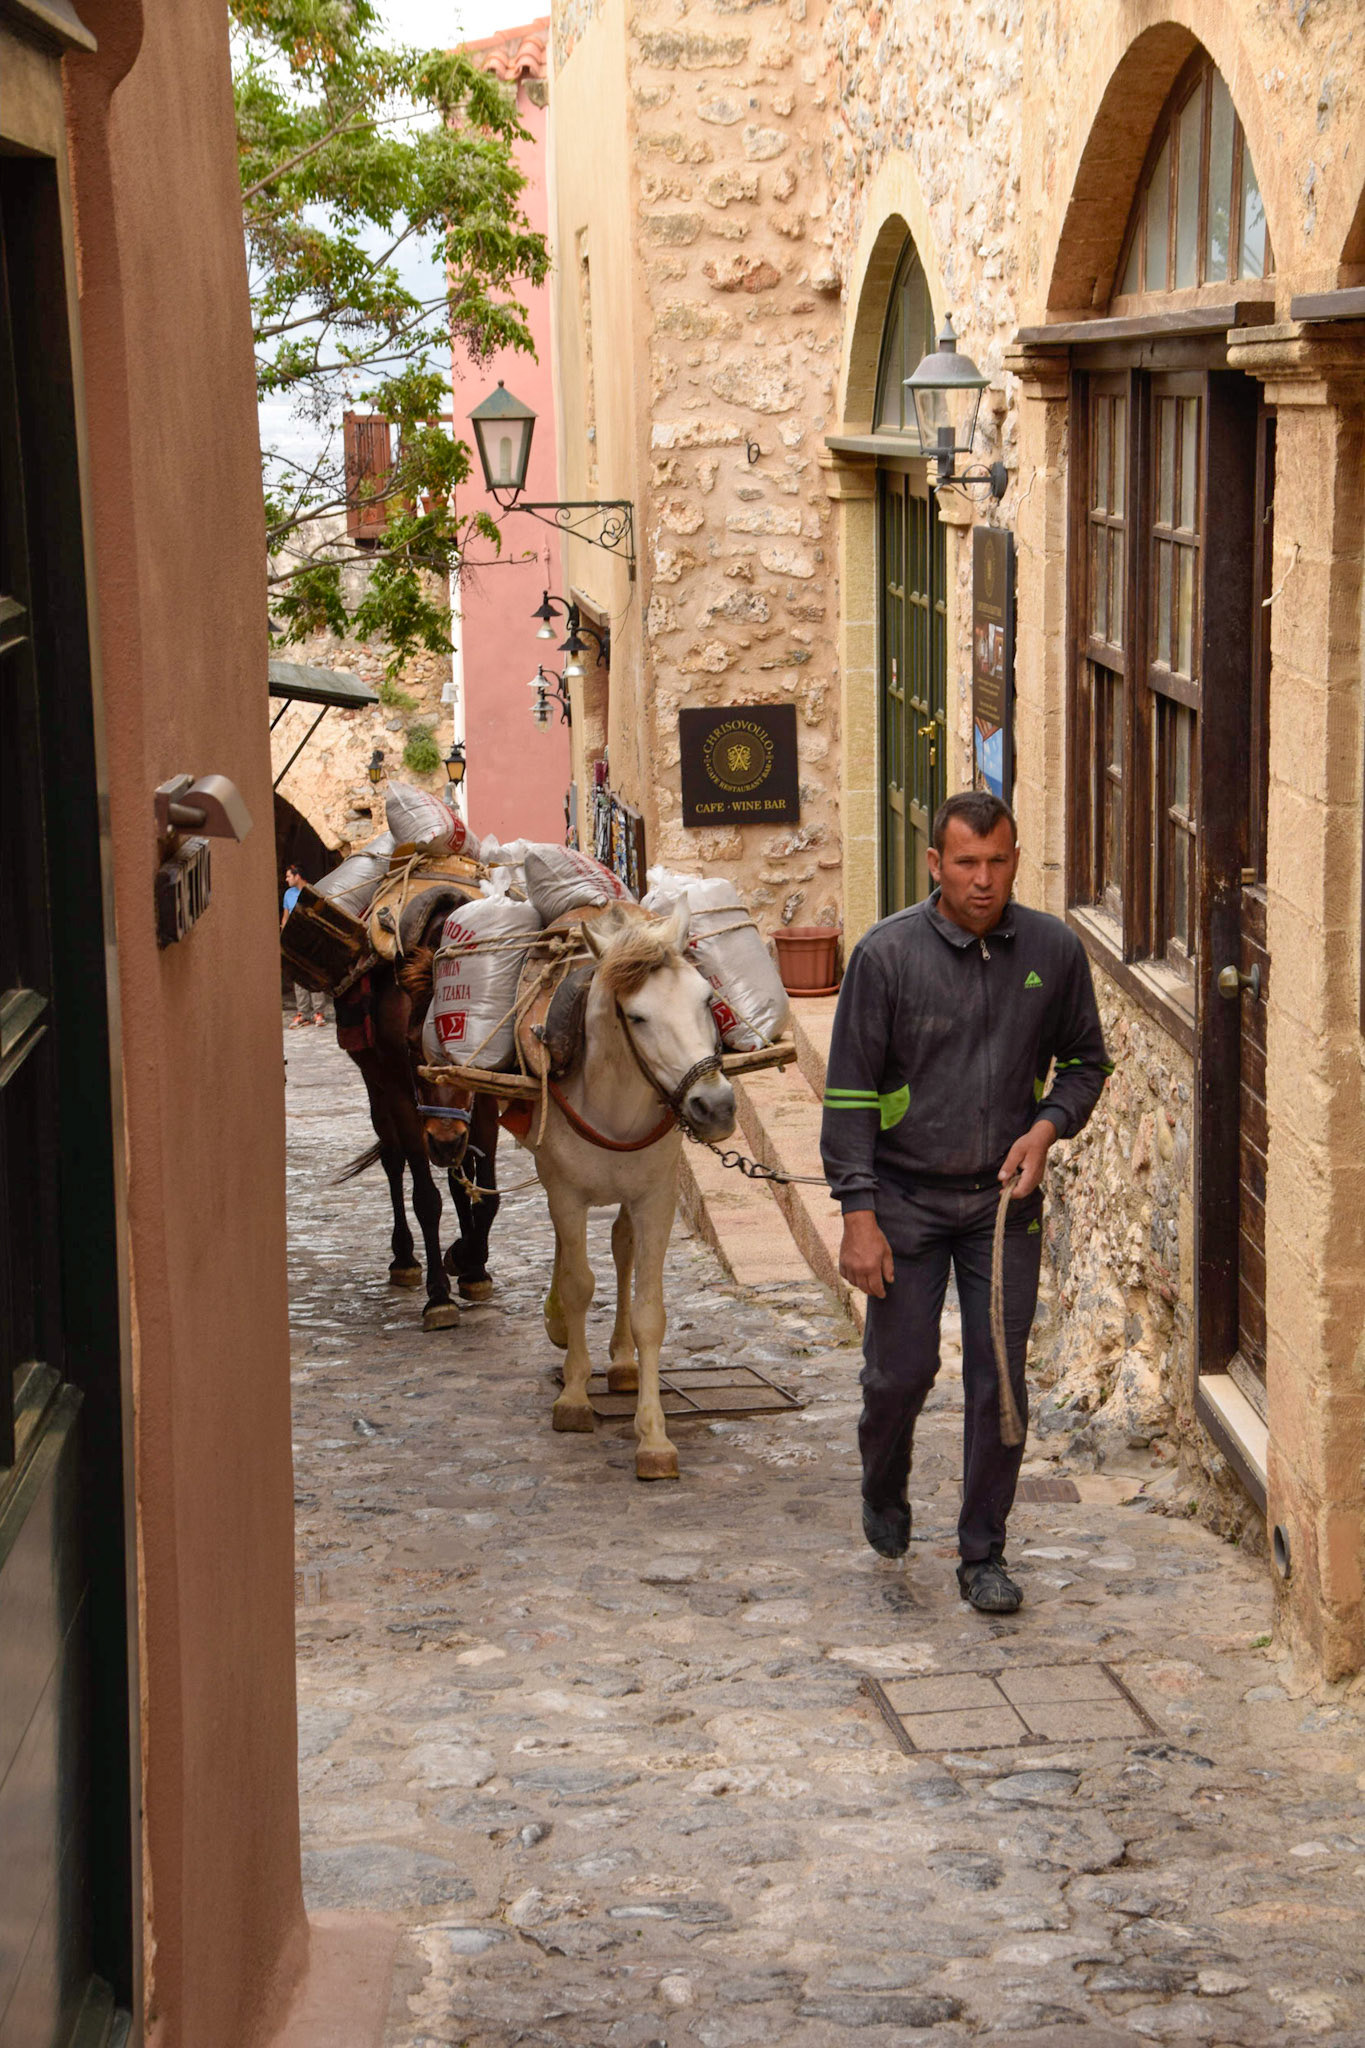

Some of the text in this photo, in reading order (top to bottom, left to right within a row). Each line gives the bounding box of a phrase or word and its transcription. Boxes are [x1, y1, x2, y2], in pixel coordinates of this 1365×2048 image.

[703, 720, 773, 753] CHRISOVOULO
[695, 799, 786, 814] CAFE WINE BAR
